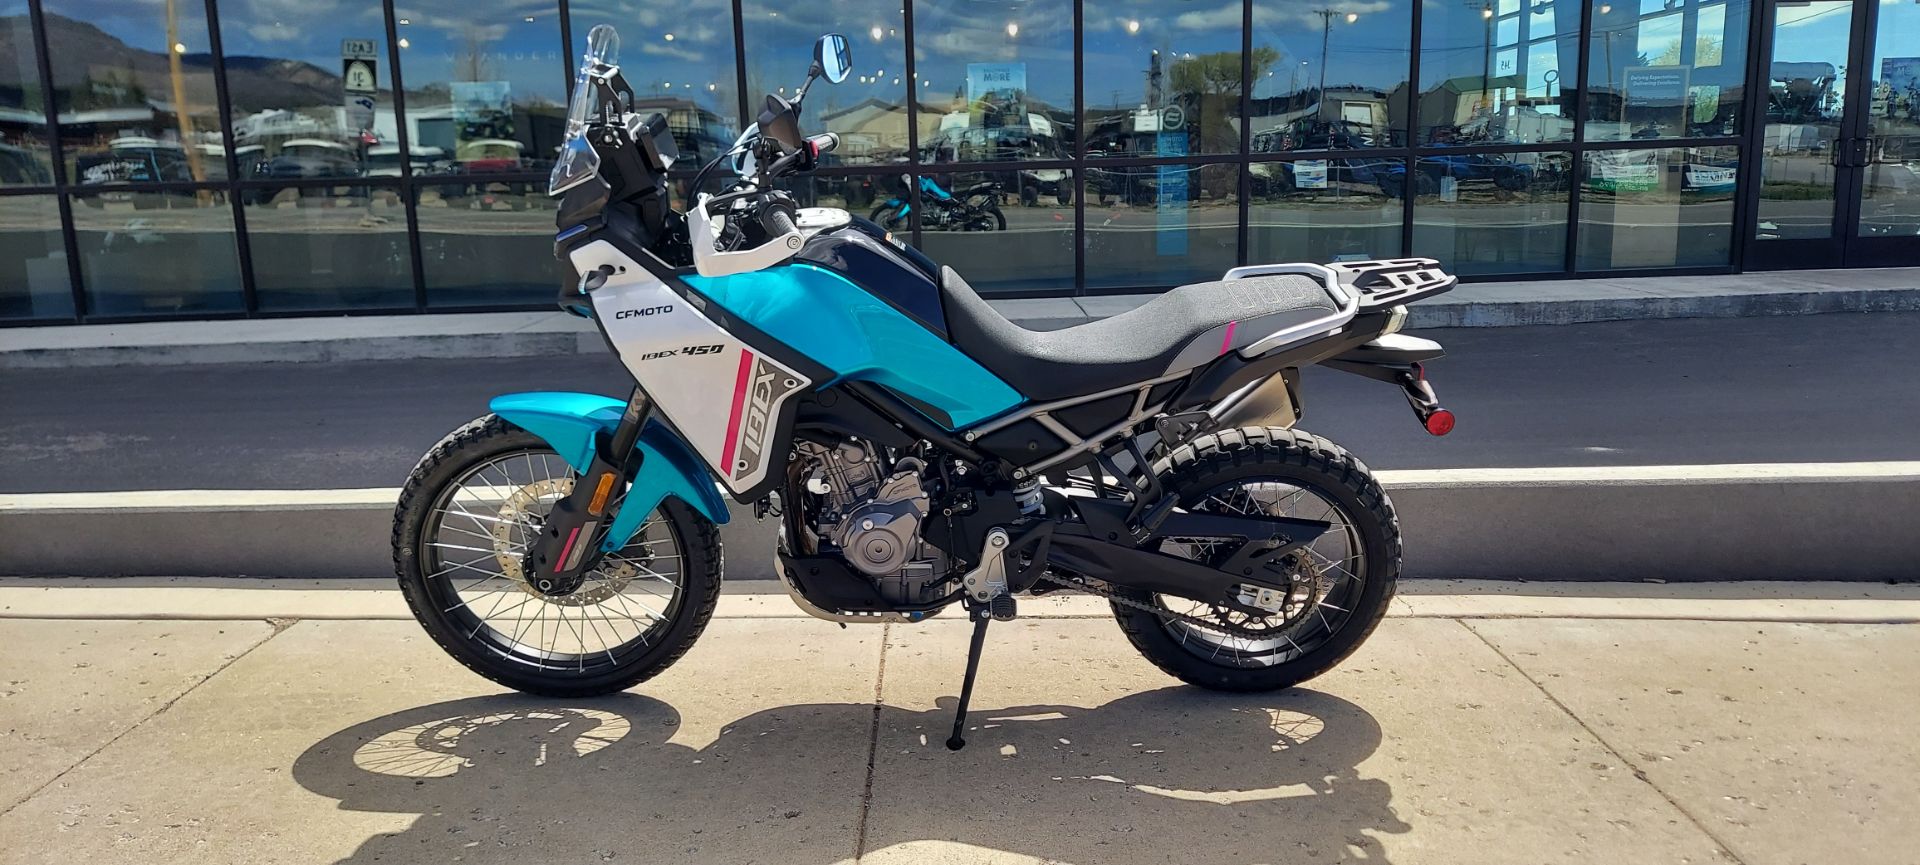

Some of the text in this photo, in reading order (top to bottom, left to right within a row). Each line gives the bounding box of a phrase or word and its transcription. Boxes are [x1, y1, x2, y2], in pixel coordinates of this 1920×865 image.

[615, 305, 674, 320] CFMOTO
[641, 344, 725, 361] IBEX 450
[744, 361, 776, 457] IBEX
